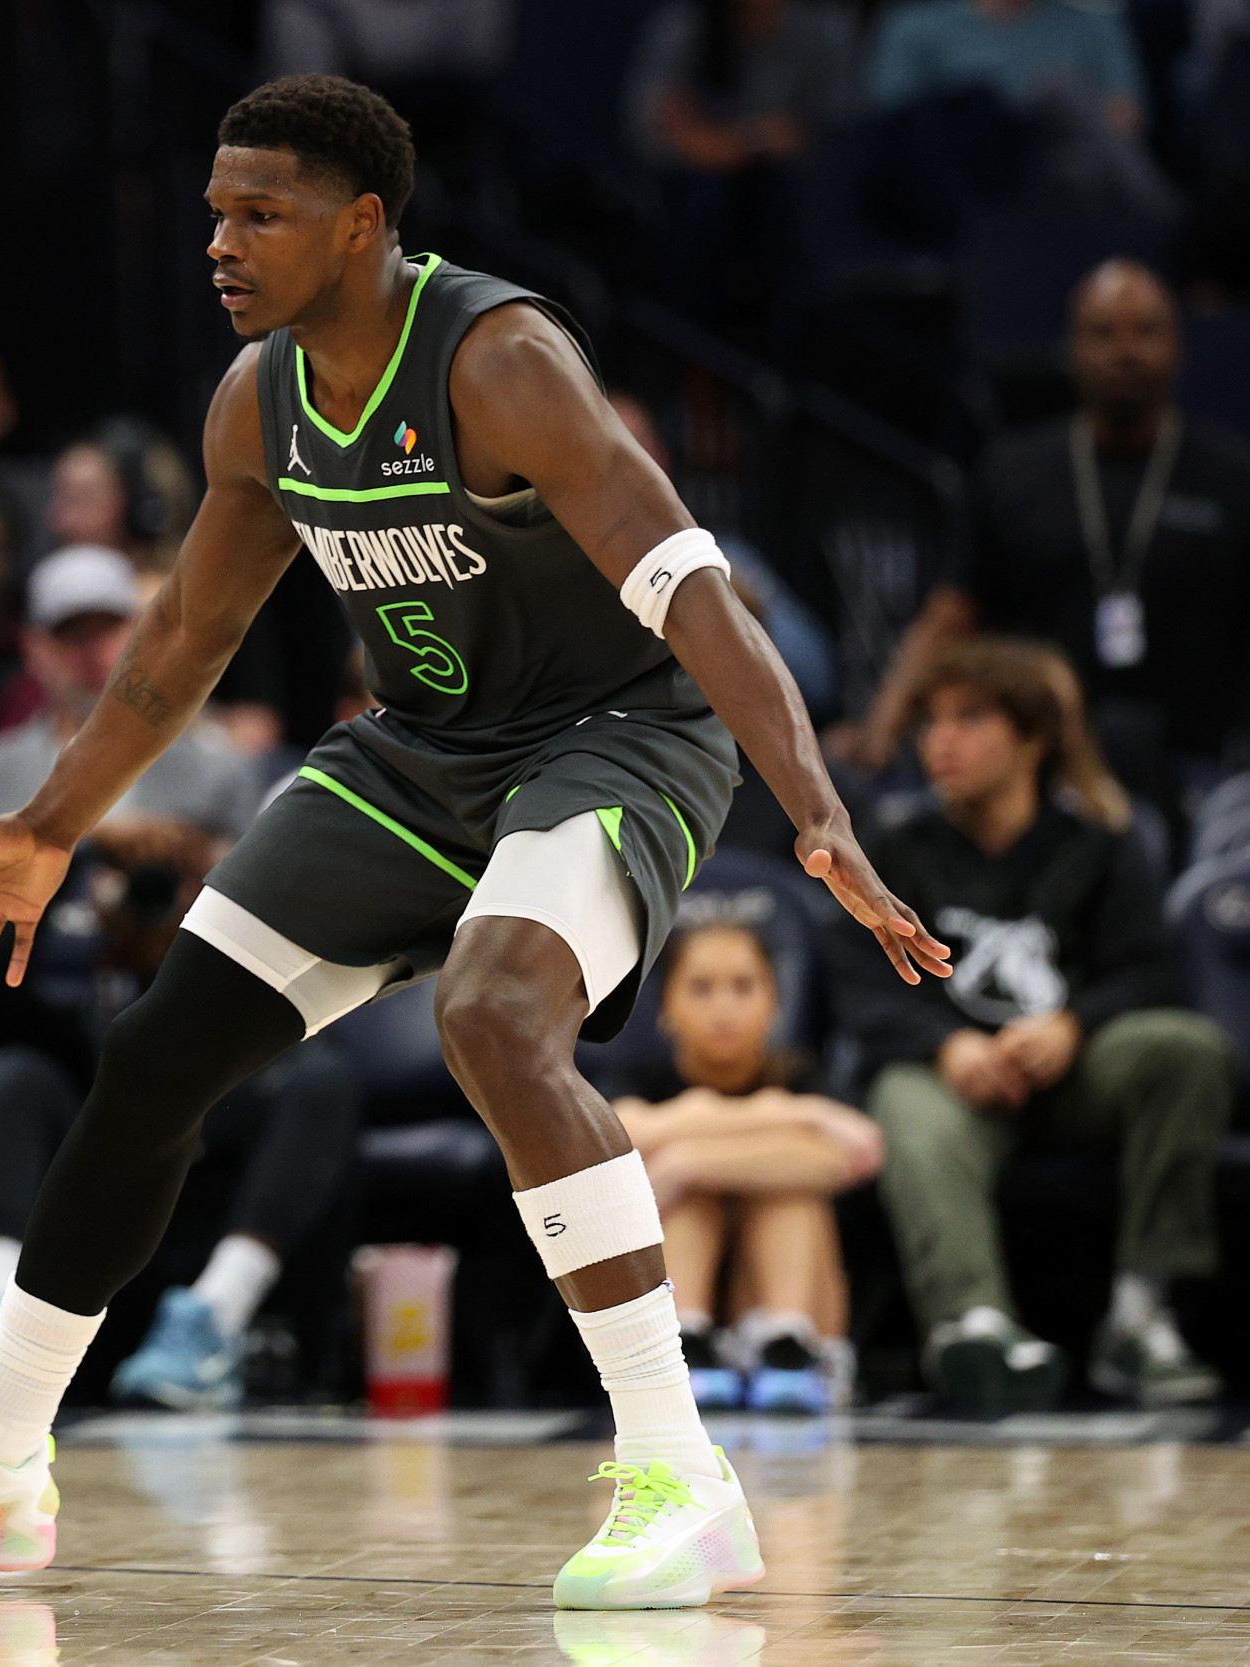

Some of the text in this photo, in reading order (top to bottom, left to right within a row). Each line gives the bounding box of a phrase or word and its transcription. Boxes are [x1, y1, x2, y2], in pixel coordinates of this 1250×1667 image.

[381, 453, 435, 476] sezzle
[650, 567, 672, 594] 5
[375, 601, 469, 695] 5
[544, 1213, 567, 1237] 5
